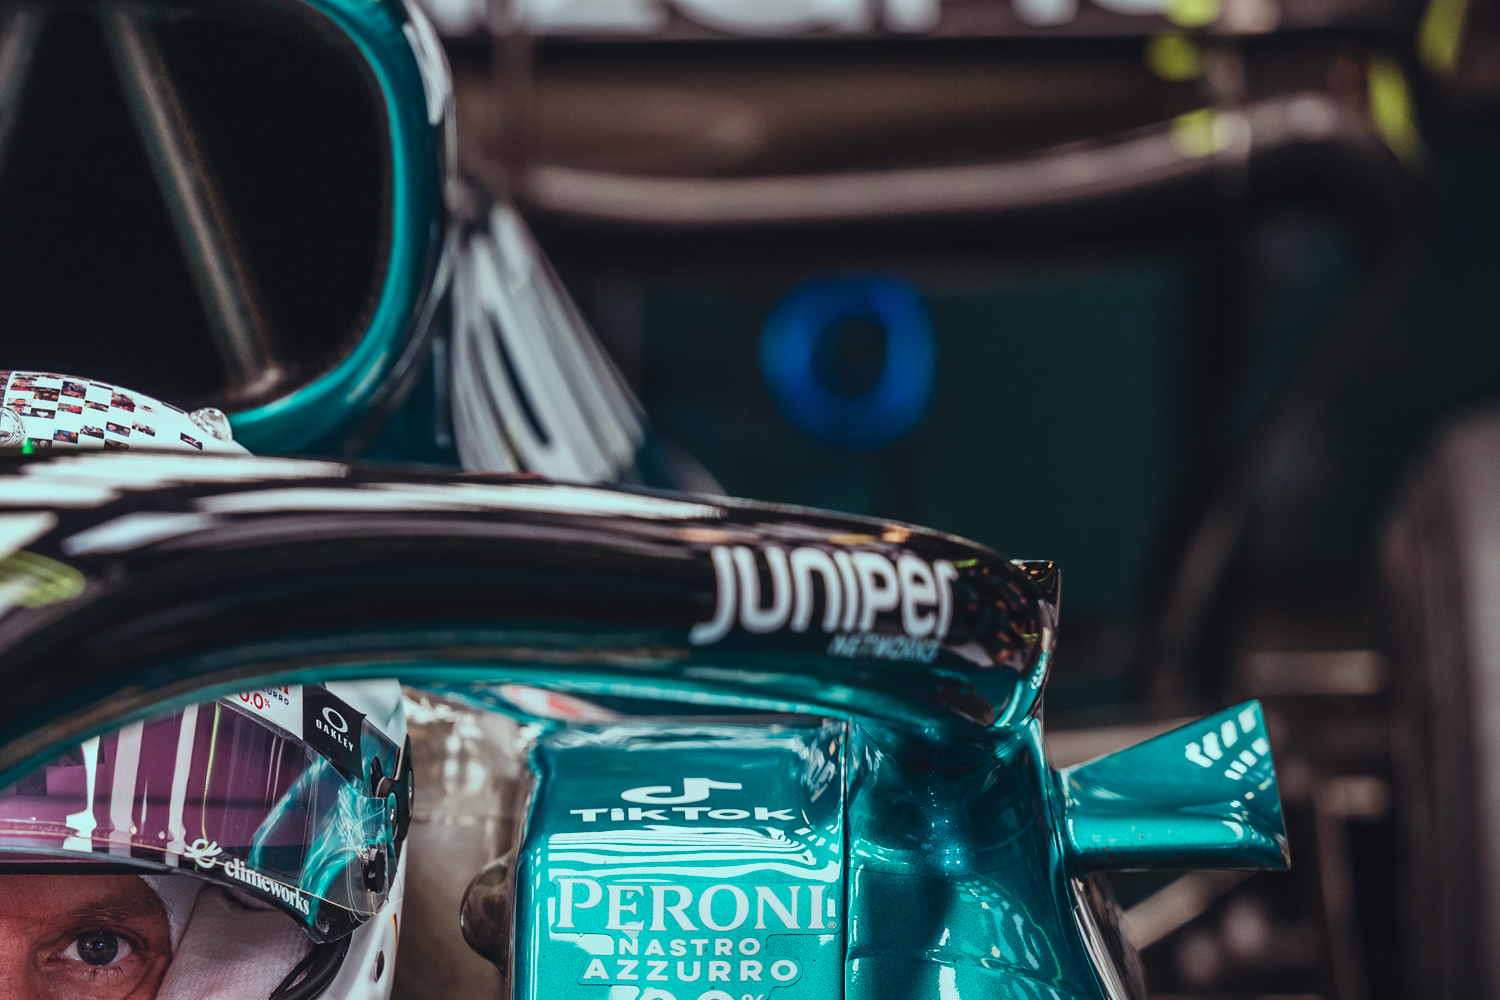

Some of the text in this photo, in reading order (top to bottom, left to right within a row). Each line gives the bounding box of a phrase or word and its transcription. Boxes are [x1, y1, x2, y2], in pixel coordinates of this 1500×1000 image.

[315, 719, 354, 752] OAKLEY
[570, 807, 795, 822] TikTok
[224, 858, 310, 915] climeworks
[556, 878, 826, 931] PERONI
[619, 938, 761, 957] NASTRO
[583, 959, 798, 982] AZZURRO
